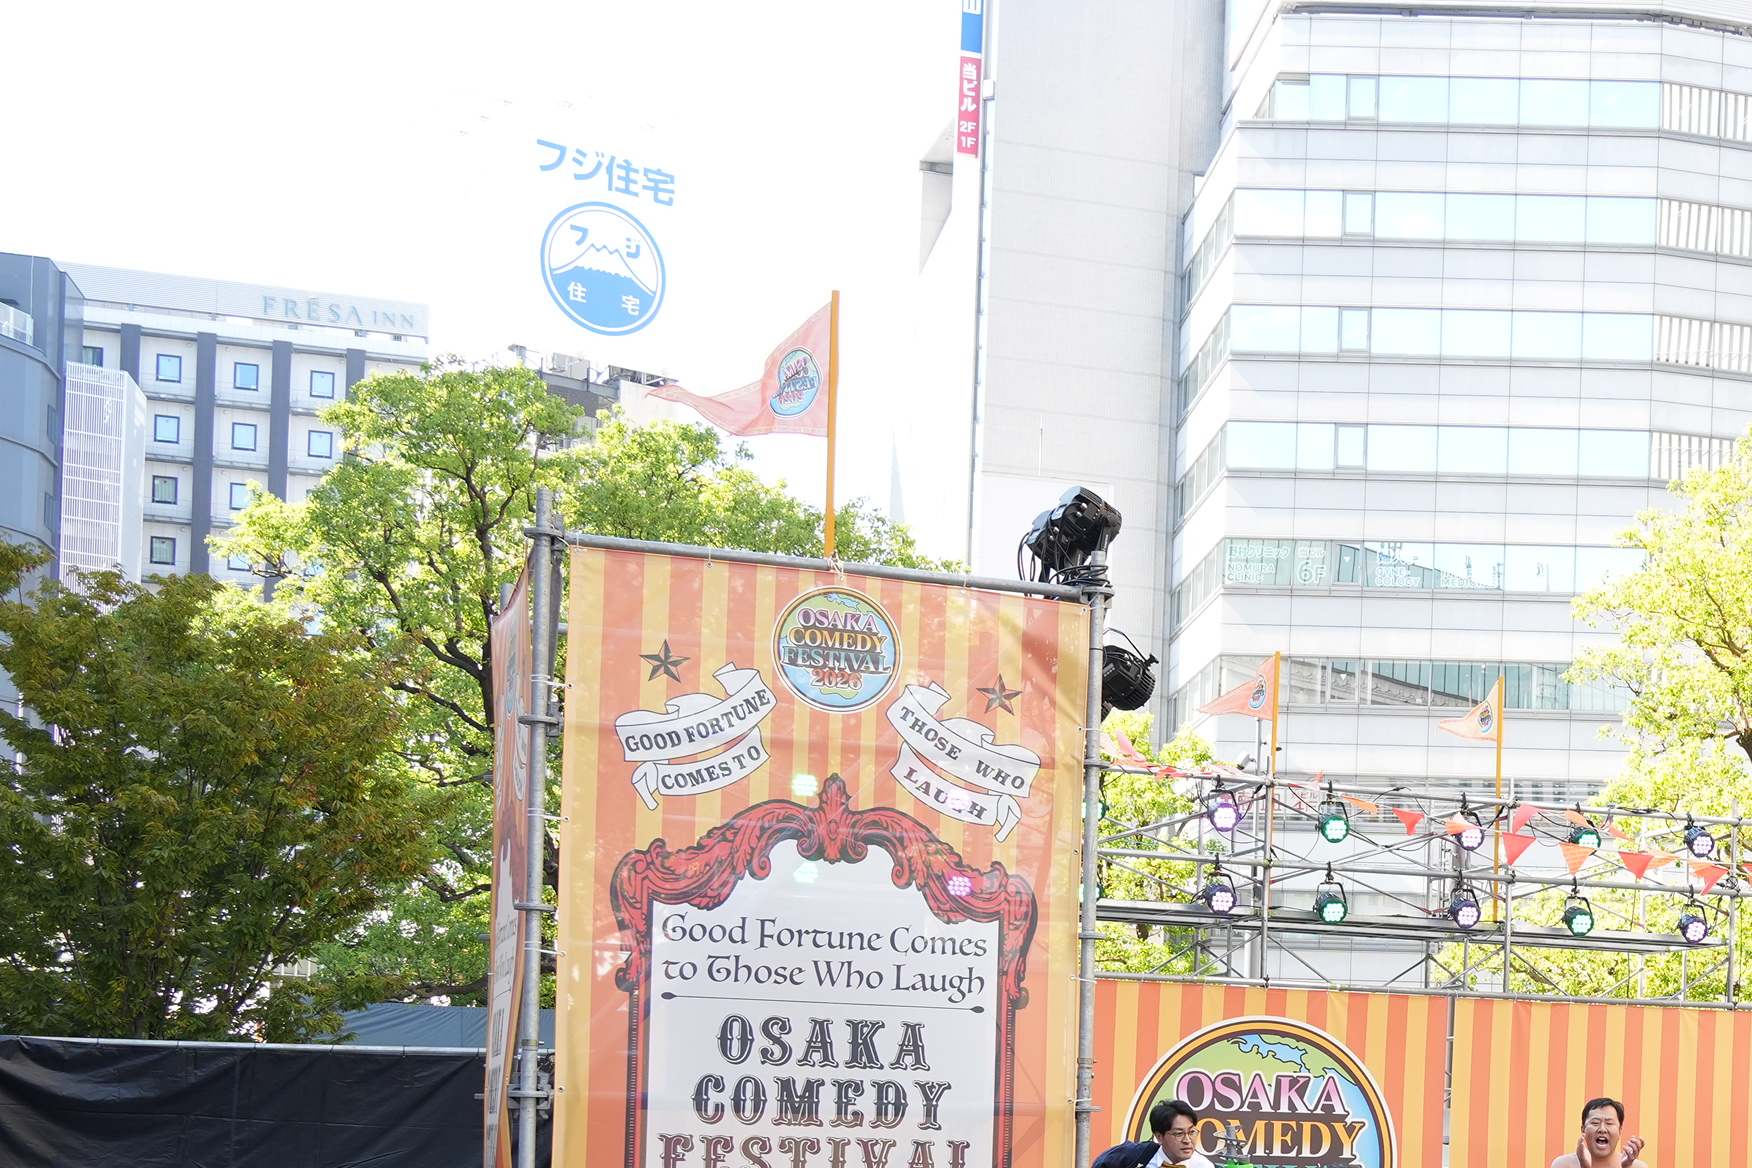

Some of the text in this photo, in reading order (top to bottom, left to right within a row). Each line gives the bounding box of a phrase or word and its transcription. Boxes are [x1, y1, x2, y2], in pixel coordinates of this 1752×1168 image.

[960, 62, 977, 112] 当ビル
[960, 121, 976, 133] 2F
[960, 137, 976, 148] 1F
[537, 138, 675, 206] フジ住宅
[373, 311, 414, 328] INN
[1227, 545, 1326, 559] 野村クリニック 当ビル
[1227, 560, 1326, 584] NOMURA 6F
[1227, 572, 1264, 582] CLINIC
[1375, 576, 1421, 587] COLOGY
[789, 626, 886, 654] COMEDY
[797, 606, 878, 635] OSAKA
[781, 644, 892, 674] FESTIVAL
[811, 667, 863, 691] 2026
[624, 688, 771, 755] GOOD FORTUNE
[660, 744, 763, 791] COMES TO
[900, 703, 1026, 792] THOSE WHO
[903, 766, 987, 822] LAUGH
[661, 912, 988, 958] Good Fortune Comes
[661, 955, 985, 1003] to Those Who Laugh
[716, 1013, 931, 1071] OSAKA
[690, 1073, 952, 1130] COMEDY
[1176, 1072, 1350, 1115] OSAKA
[1195, 1118, 1364, 1159] OMEDY
